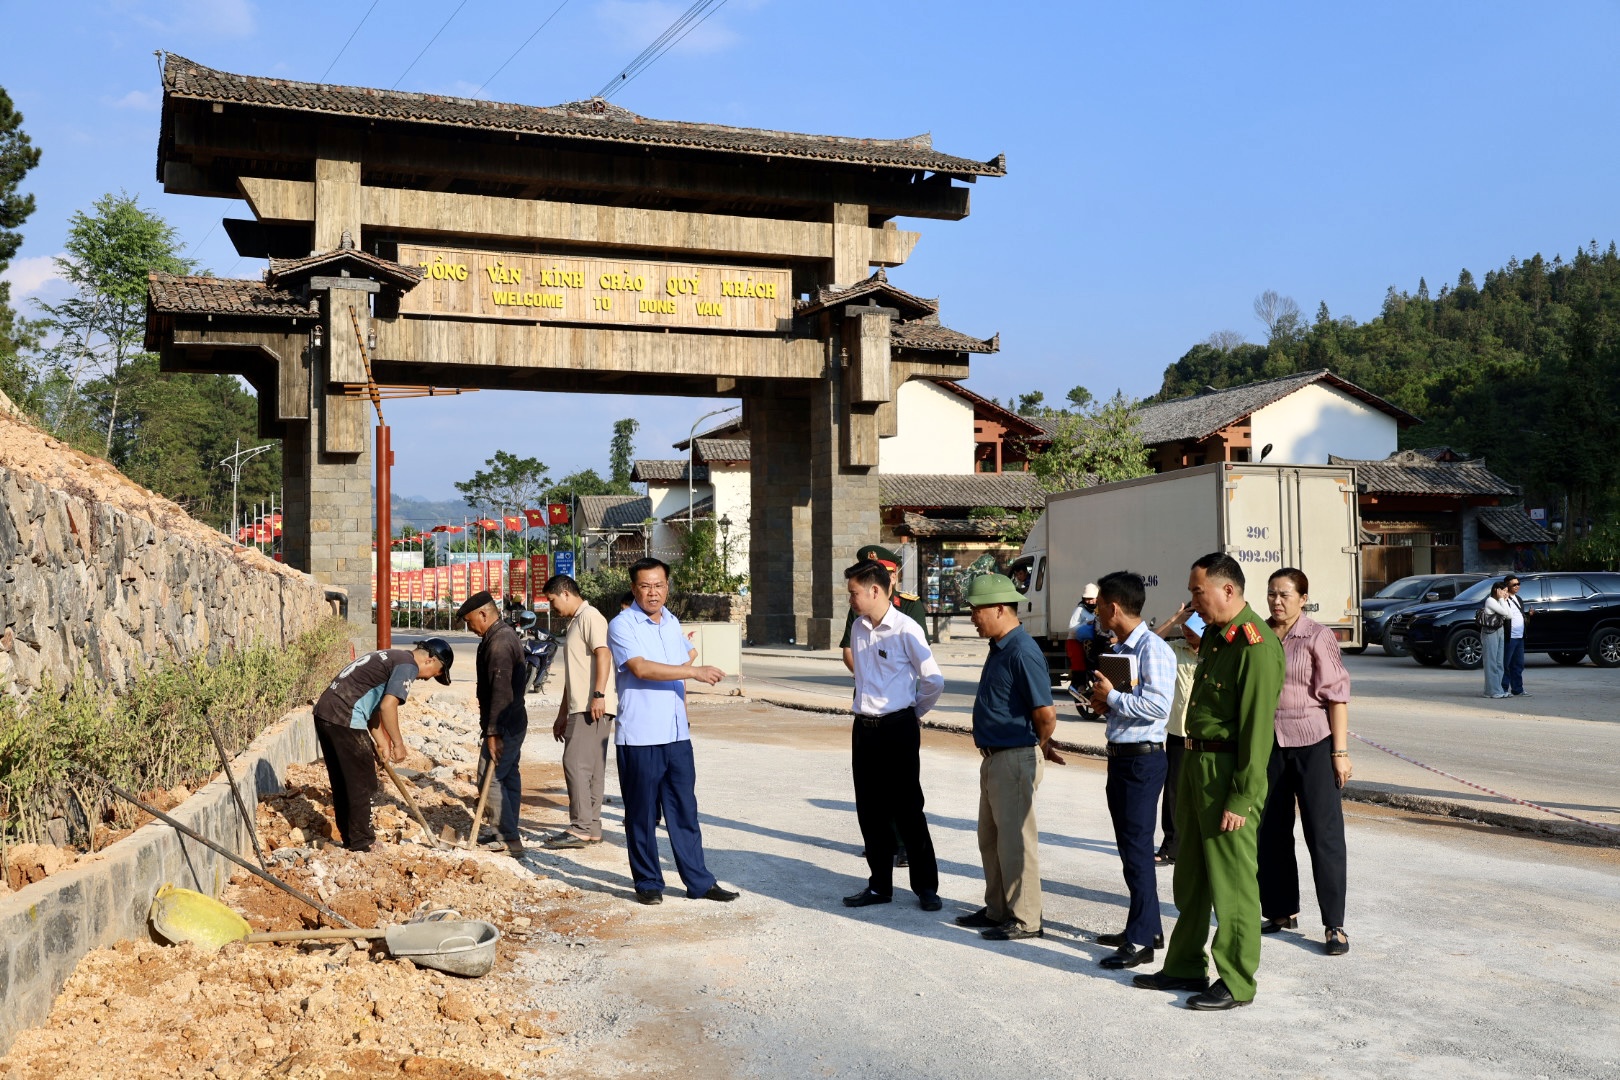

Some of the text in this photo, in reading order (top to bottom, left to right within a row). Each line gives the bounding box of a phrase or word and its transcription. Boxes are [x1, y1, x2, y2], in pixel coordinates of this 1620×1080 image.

[487, 261, 522, 285] VĂN
[540, 264, 585, 288] KÍNH
[599, 269, 646, 292] CHÀO
[666, 272, 701, 297] QUÝ
[721, 275, 777, 299] KHÁCH
[492, 291, 723, 317] WELCOME TO DONG VAN
[1246, 525, 1270, 540] 29C
[1238, 550, 1280, 563] 992.96
